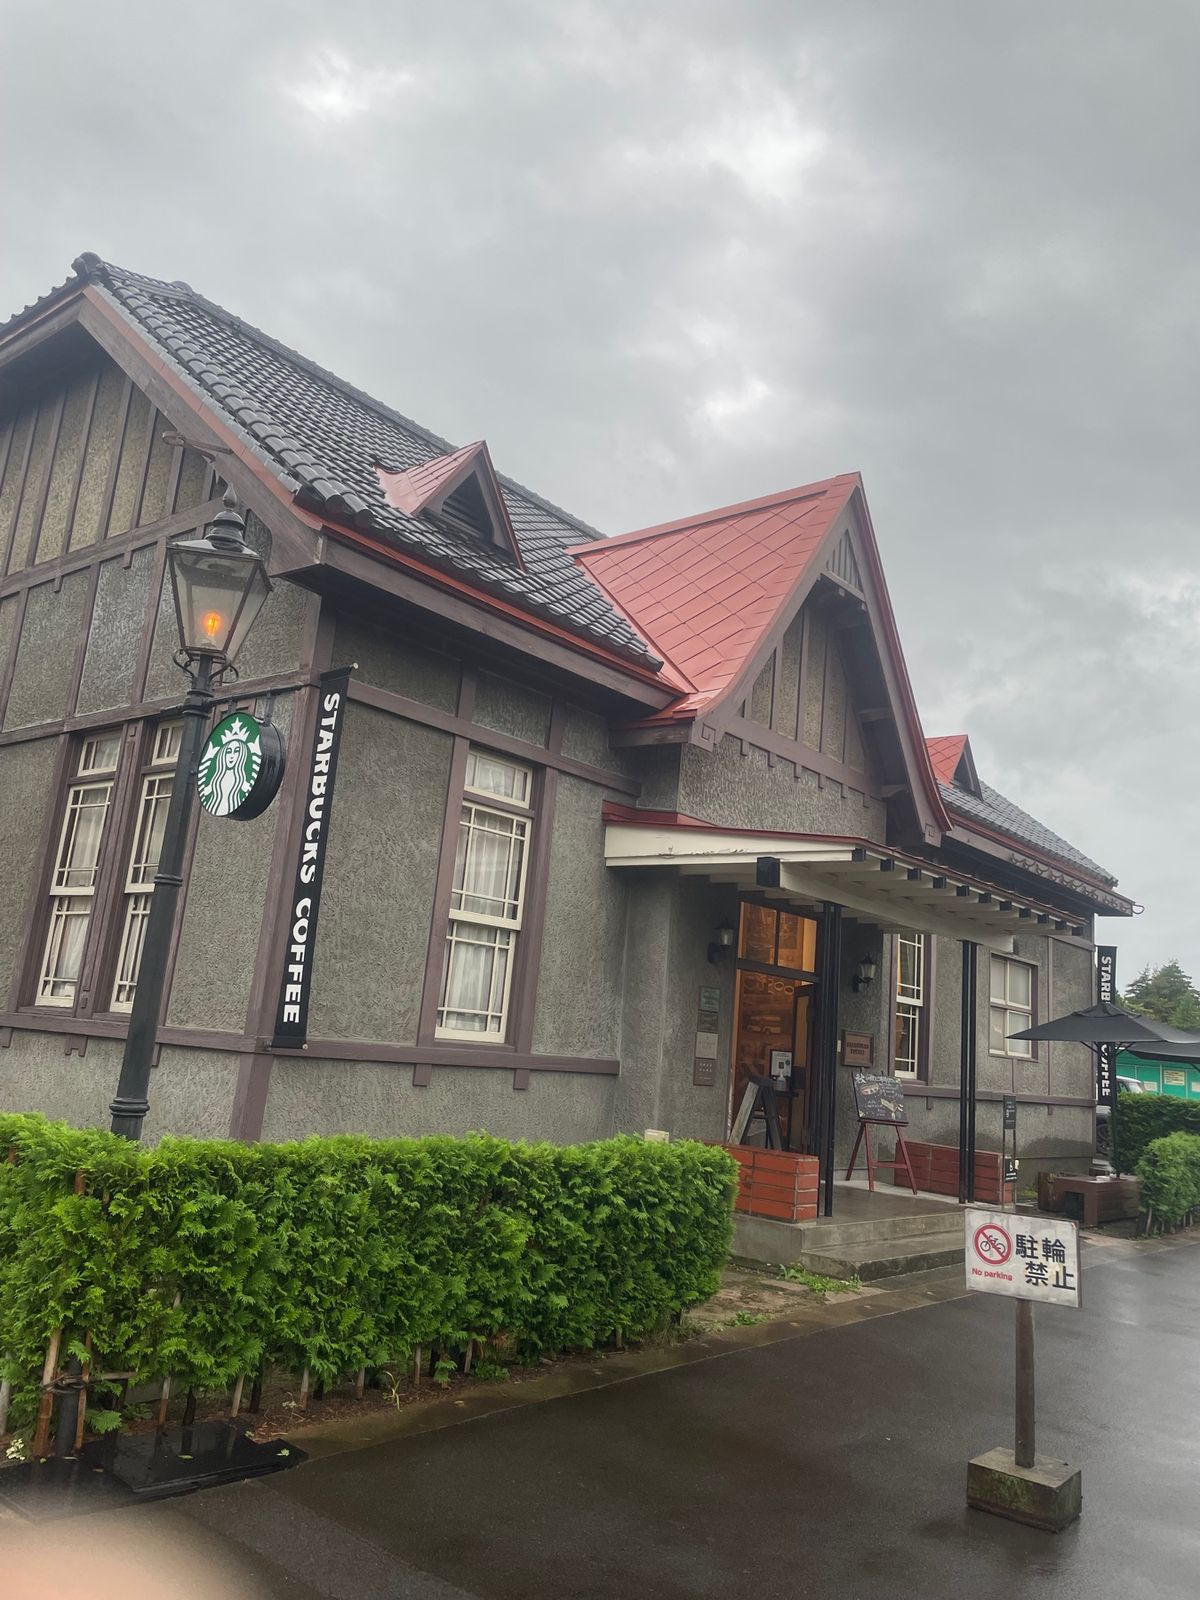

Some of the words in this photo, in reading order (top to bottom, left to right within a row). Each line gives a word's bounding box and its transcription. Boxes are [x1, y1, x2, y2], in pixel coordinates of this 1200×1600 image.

[300, 692, 341, 884] STARBUCKS
[282, 897, 312, 1024] COFFEE
[1101, 956, 1112, 1003] STARB
[1015, 1234, 1066, 1264] 駐輪
[971, 1267, 983, 1276] No
[984, 1269, 1013, 1281] parking
[1025, 1261, 1076, 1291] 禁止
